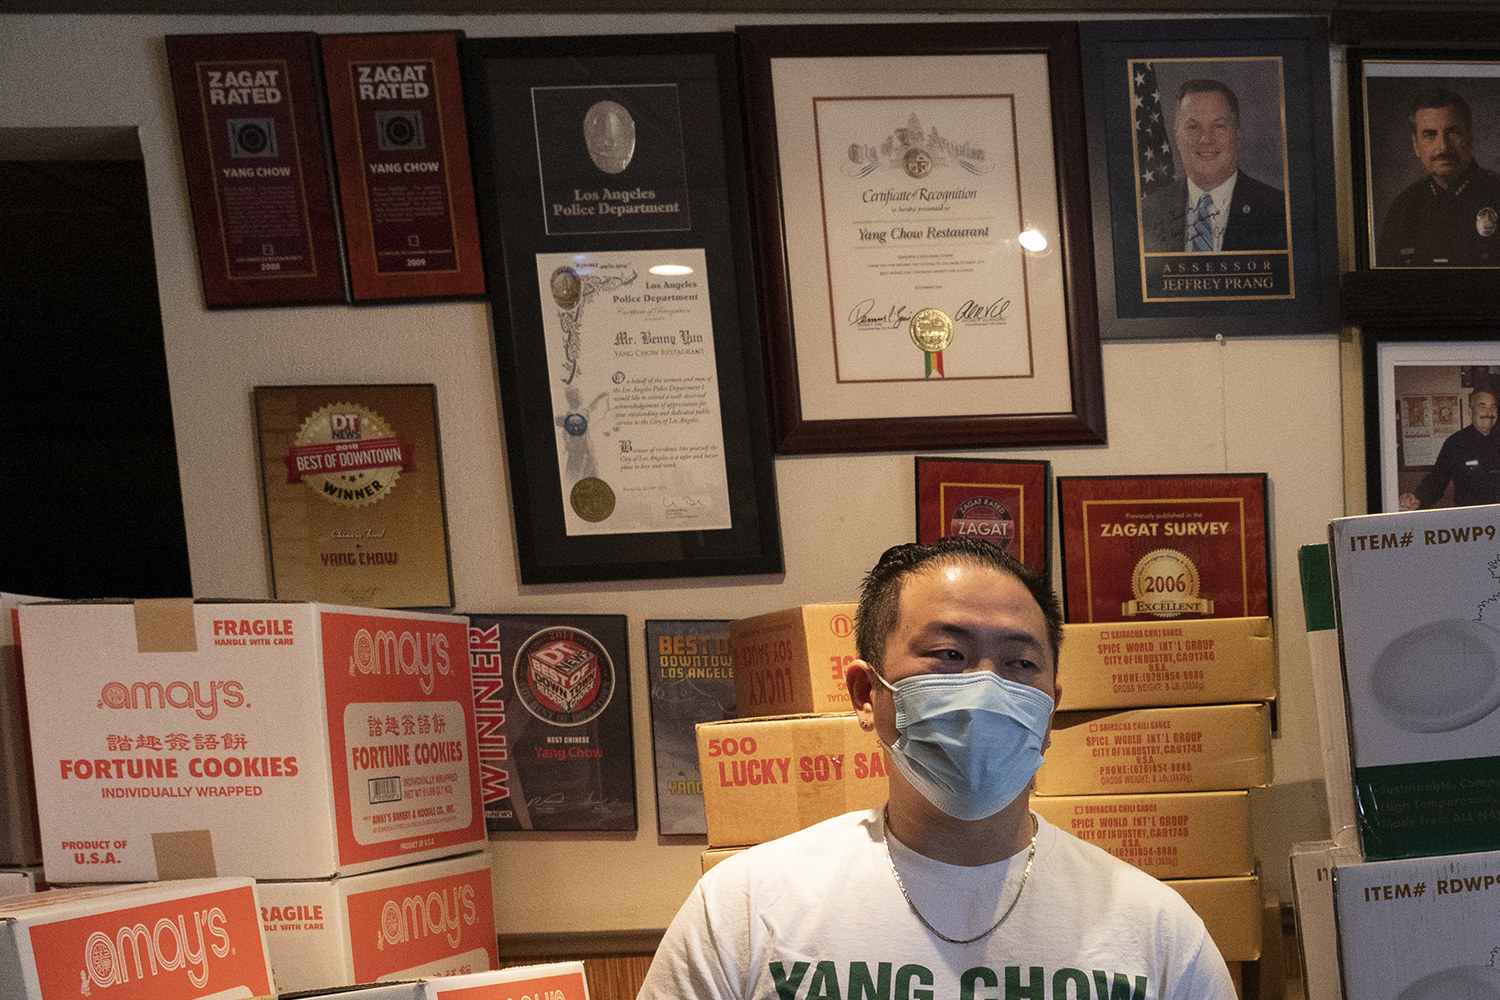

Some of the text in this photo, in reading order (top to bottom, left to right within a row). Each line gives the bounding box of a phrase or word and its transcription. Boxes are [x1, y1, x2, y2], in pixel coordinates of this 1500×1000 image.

[208, 70, 279, 88] ZAGAT
[358, 65, 426, 83] ZAGAT
[210, 88, 282, 105] RATED
[359, 82, 429, 100] RATED
[223, 167, 291, 178] YANG CHOW
[369, 162, 440, 174] YANG CHOW
[574, 187, 655, 203] Los Angeles
[862, 187, 977, 209] Certificate Recognition
[553, 202, 680, 218] Police Department
[858, 225, 989, 244] Yang Chow Restaurant
[406, 258, 426, 267] 2009
[646, 280, 697, 290] Los Angeles
[1163, 276, 1274, 291] JEFFREY PRANG
[613, 294, 698, 304] Police Department
[613, 332, 637, 346] Mr.
[641, 331, 676, 345] Benny
[332, 414, 358, 430] DT
[332, 430, 360, 440] NEWS
[296, 447, 402, 471] BEST OF DOWNTOWN
[323, 479, 384, 501] WINNER
[1155, 510, 1185, 520] published
[957, 520, 1008, 537] ZAGAT
[1100, 521, 1230, 538] ZAGAT SURVEY
[1350, 525, 1497, 552] ITEM# RDWP9
[320, 551, 399, 566] YANG CHOW
[1145, 572, 1186, 593] 2006
[1136, 601, 1200, 612] EXCELLENT
[213, 619, 293, 637] FRAGILE
[214, 636, 294, 647] HANDLE WITH CARE
[659, 634, 713, 655] BEST
[1097, 643, 1121, 655] SPICE
[1126, 641, 1154, 653] WORLD
[1185, 639, 1215, 651] GROUP
[660, 655, 734, 667] DOWNTOW
[661, 667, 735, 679] LOS ANGELE
[470, 623, 510, 805] WINNER
[547, 736, 590, 744] BEST CHINESE
[708, 736, 757, 758] 500
[352, 741, 463, 771] FORTUNE COOKIES
[535, 746, 603, 761] Yang Chow
[60, 755, 299, 781] FORTUNE COOKIES
[719, 754, 844, 788] LUCKY SOY
[101, 784, 263, 799] INDIVIDUALLY WRAPPED
[61, 839, 128, 851] PRODUCT OF
[73, 851, 122, 865] U.S.A.
